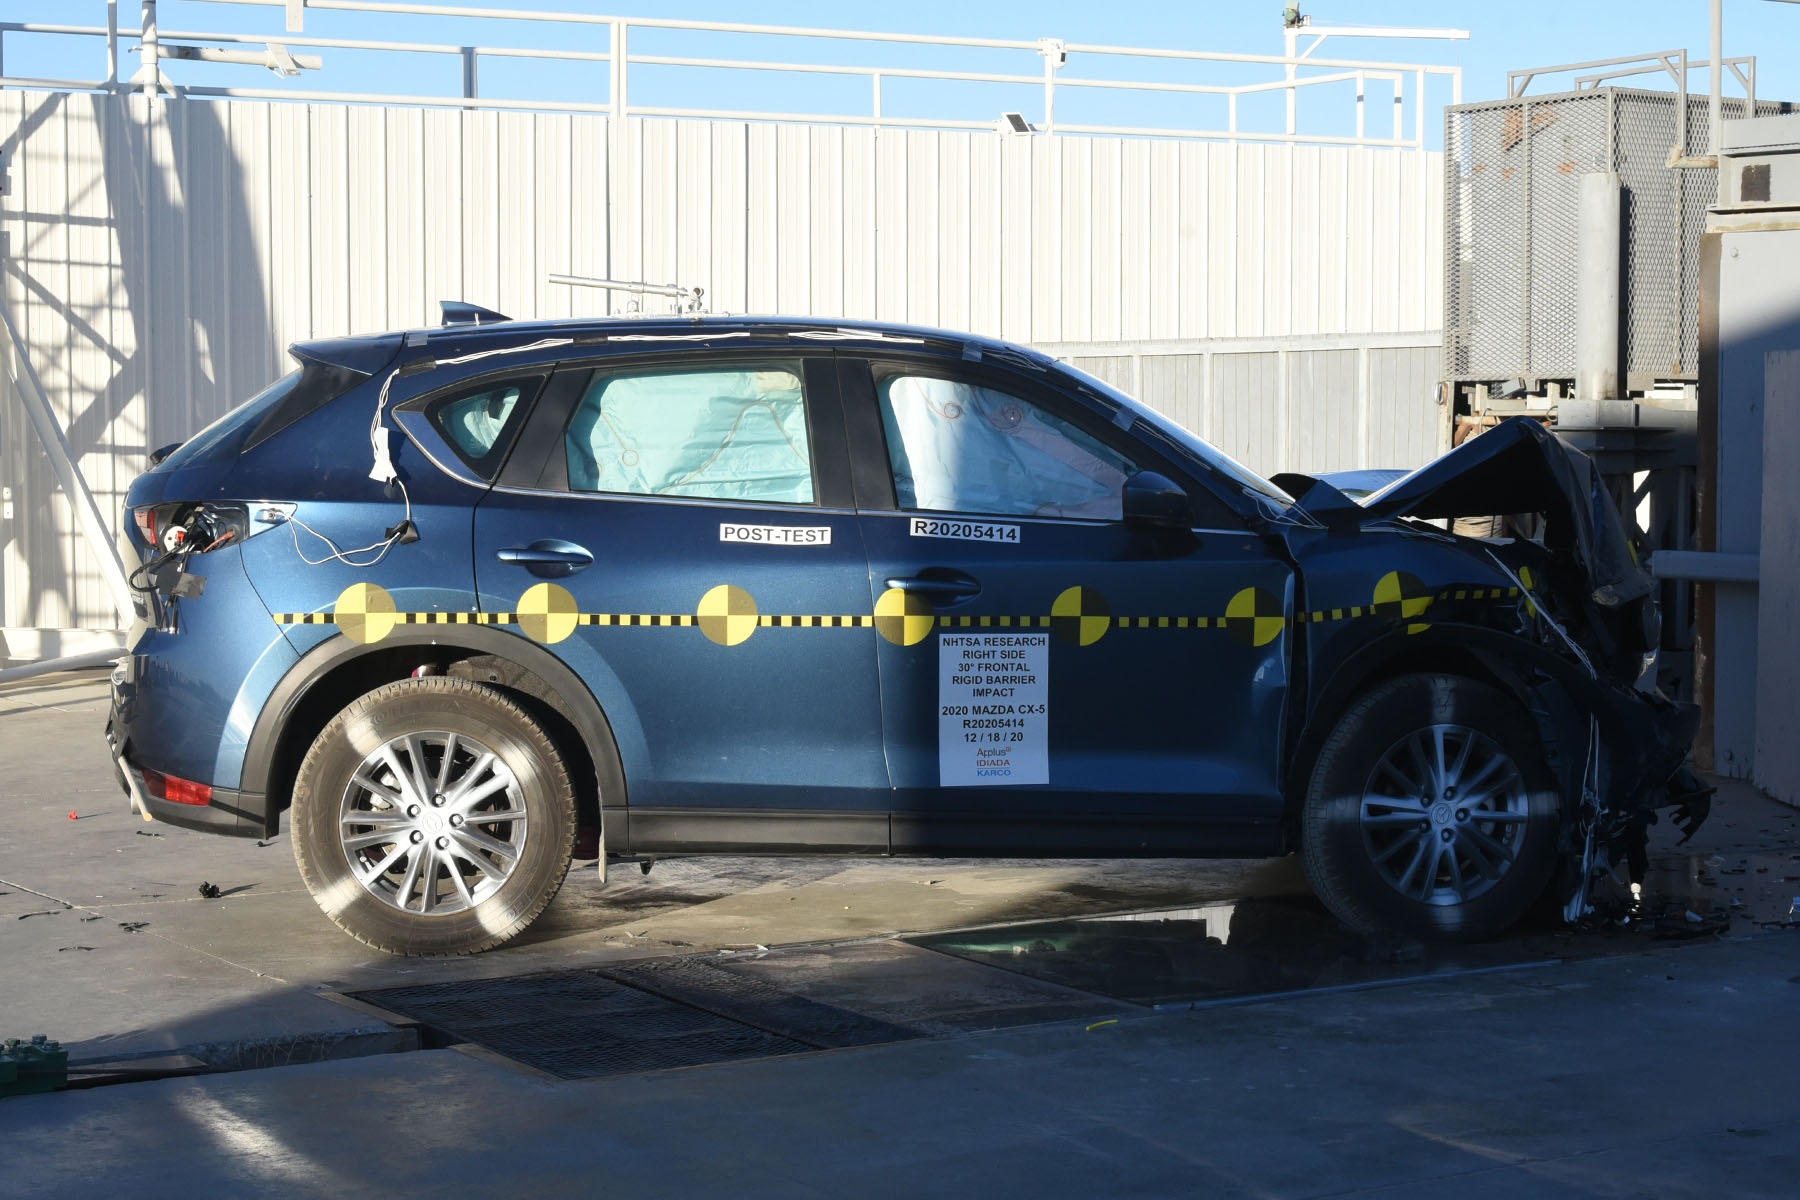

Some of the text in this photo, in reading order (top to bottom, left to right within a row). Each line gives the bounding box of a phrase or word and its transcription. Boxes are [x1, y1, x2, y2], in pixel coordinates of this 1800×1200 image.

[724, 527, 829, 542] POST-TEST
[915, 521, 1017, 540] R20205414
[943, 638, 1046, 646] NHTSA RESEARCH
[963, 650, 1026, 659] RIGHT SIDE
[978, 663, 1030, 672] FRONTAL
[952, 676, 1036, 684] RIGID BARRIER
[973, 688, 1015, 697] IMPACT
[942, 704, 1046, 716] 2020 MAZDA CX-5
[963, 719, 1024, 728] R20205414
[964, 734, 977, 742] 12
[988, 733, 1000, 742] 18
[1010, 732, 1024, 742] 20
